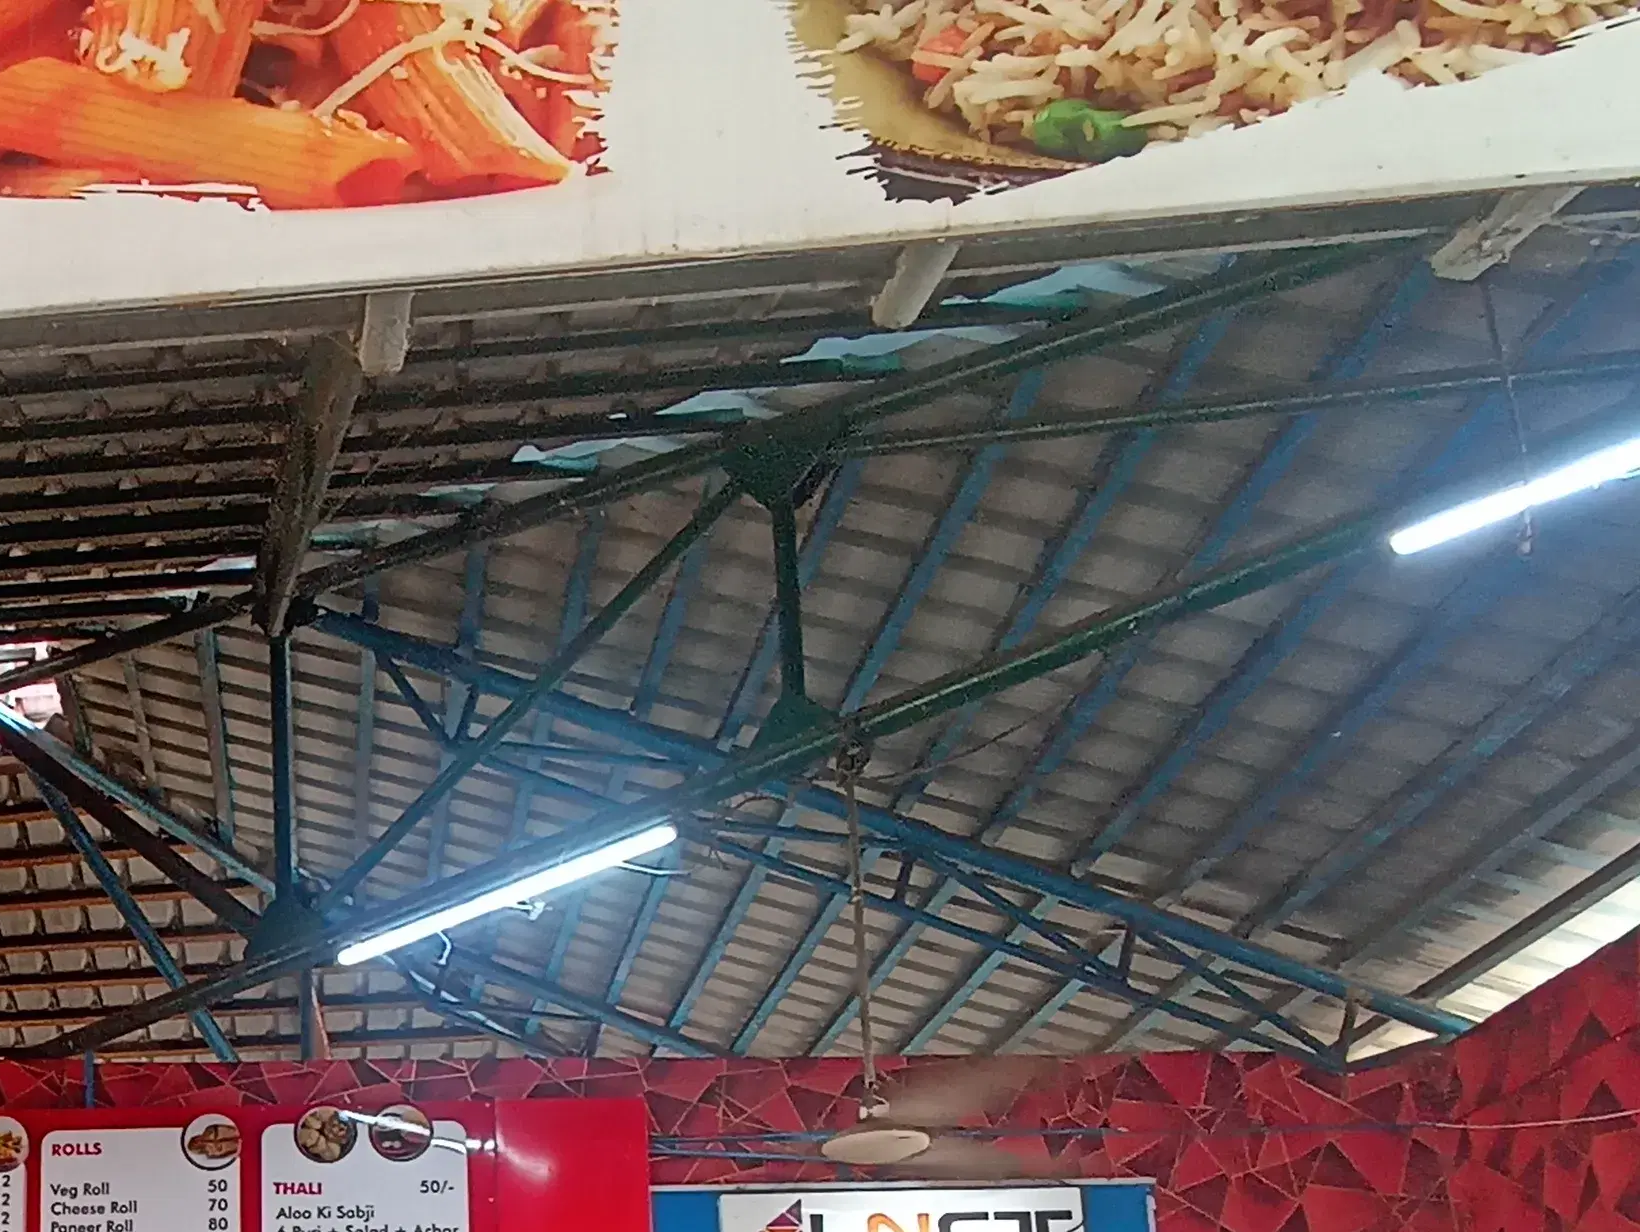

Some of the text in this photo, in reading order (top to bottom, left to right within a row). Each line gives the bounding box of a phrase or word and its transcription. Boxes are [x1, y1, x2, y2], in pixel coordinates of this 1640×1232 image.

[52, 1142, 102, 1157] ROLLS
[50, 1179, 228, 1200] Veg Roll 50
[273, 1180, 454, 1195] THALI 50/-
[50, 1198, 228, 1216] Cheese Roll 70
[276, 1205, 374, 1223] Aloo Ki Sabji
[106, 1219, 133, 1232] Roll
[208, 1217, 228, 1231] 80
